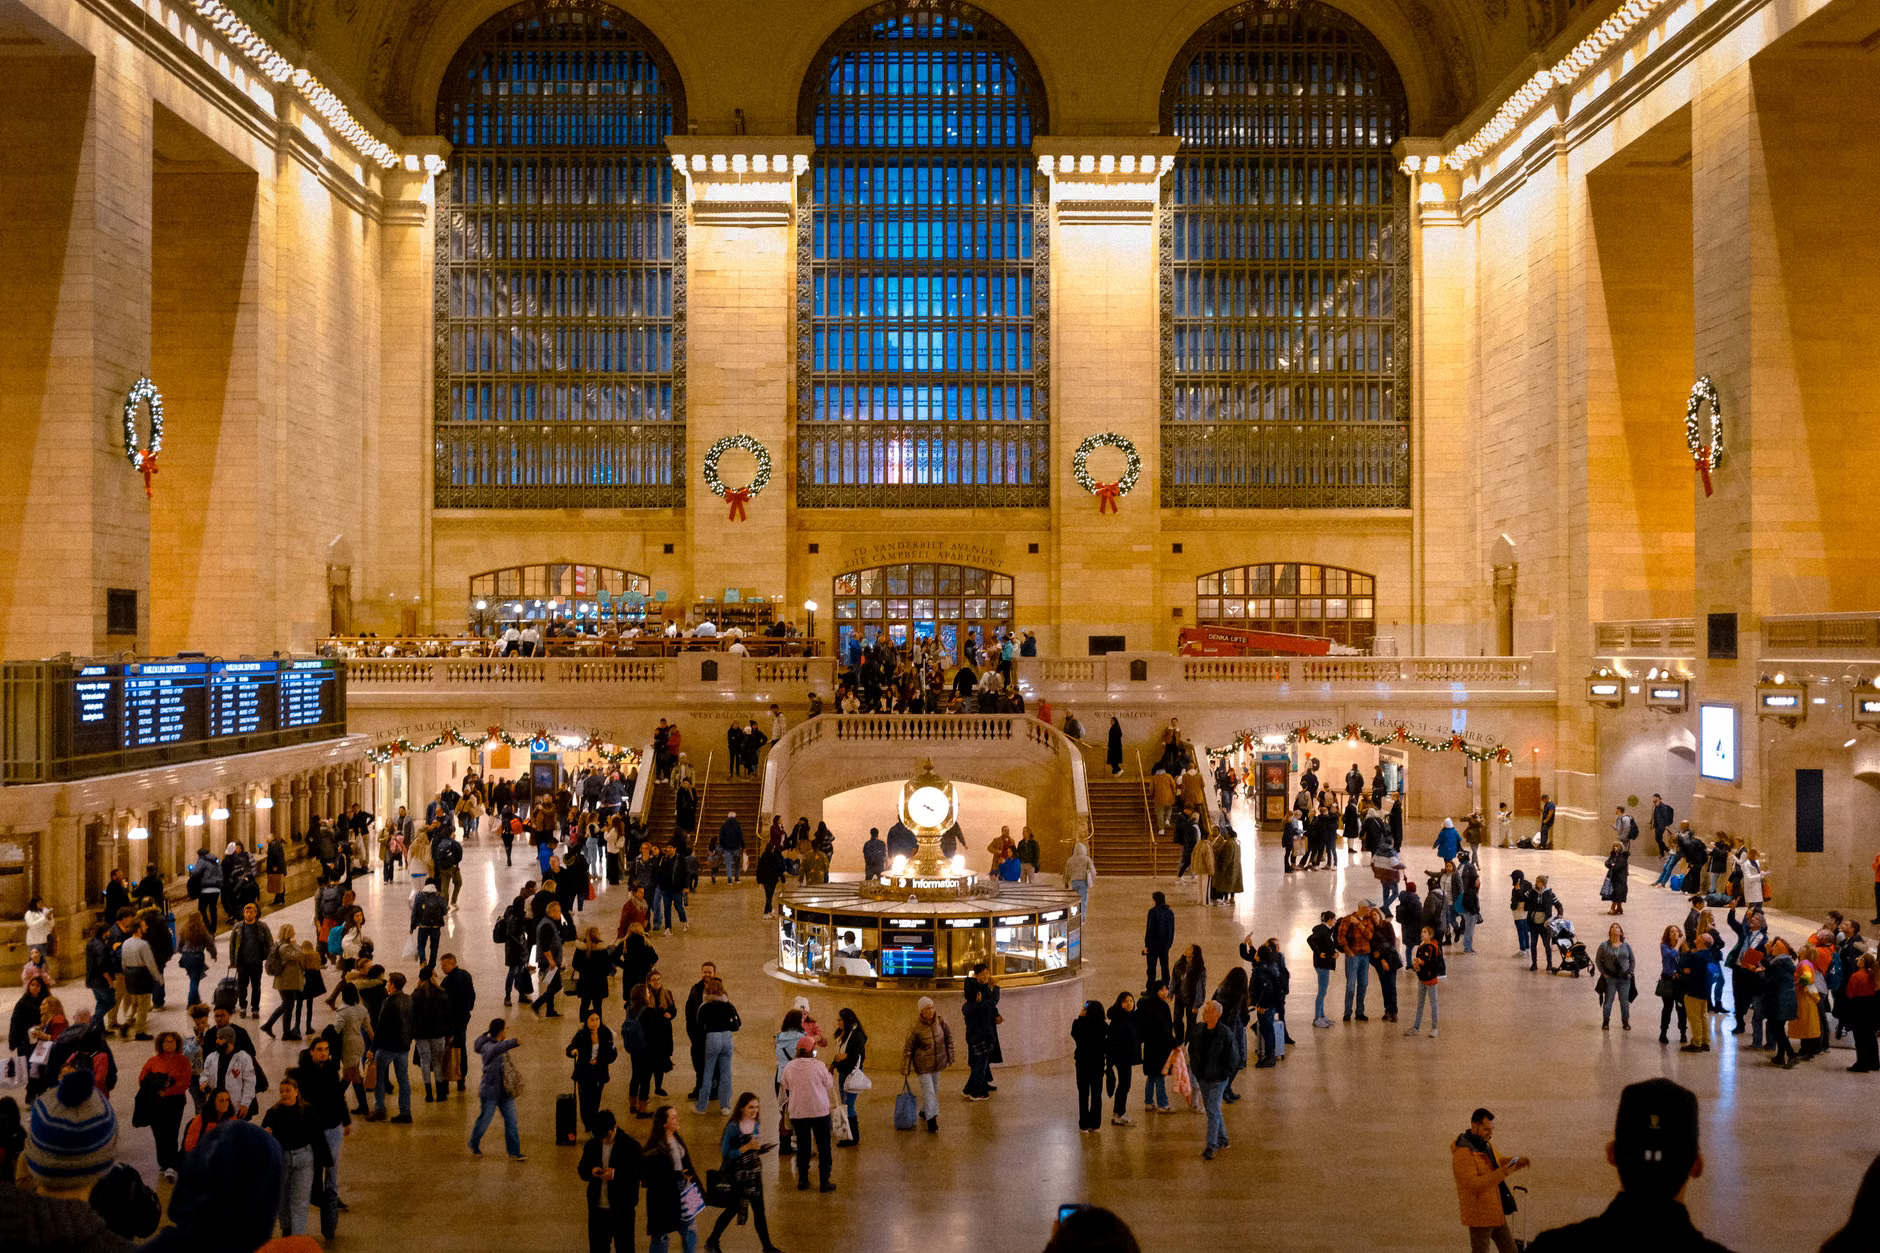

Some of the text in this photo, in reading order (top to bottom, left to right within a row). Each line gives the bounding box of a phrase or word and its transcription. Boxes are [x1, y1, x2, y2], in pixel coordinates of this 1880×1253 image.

[853, 541, 995, 557] TO VANDERBILT AVENUE
[843, 550, 1004, 568] THE CAMPBELL APARTMENT
[1094, 711, 1158, 719] WEST BALCONY
[375, 719, 476, 740] ICKET MACHINES
[516, 720, 560, 731] SUBWAY
[1232, 718, 1333, 737] TICKET MACHINES
[1372, 719, 1415, 729] TRACKS
[1437, 725, 1449, 734] 42
[912, 878, 960, 888] Information
